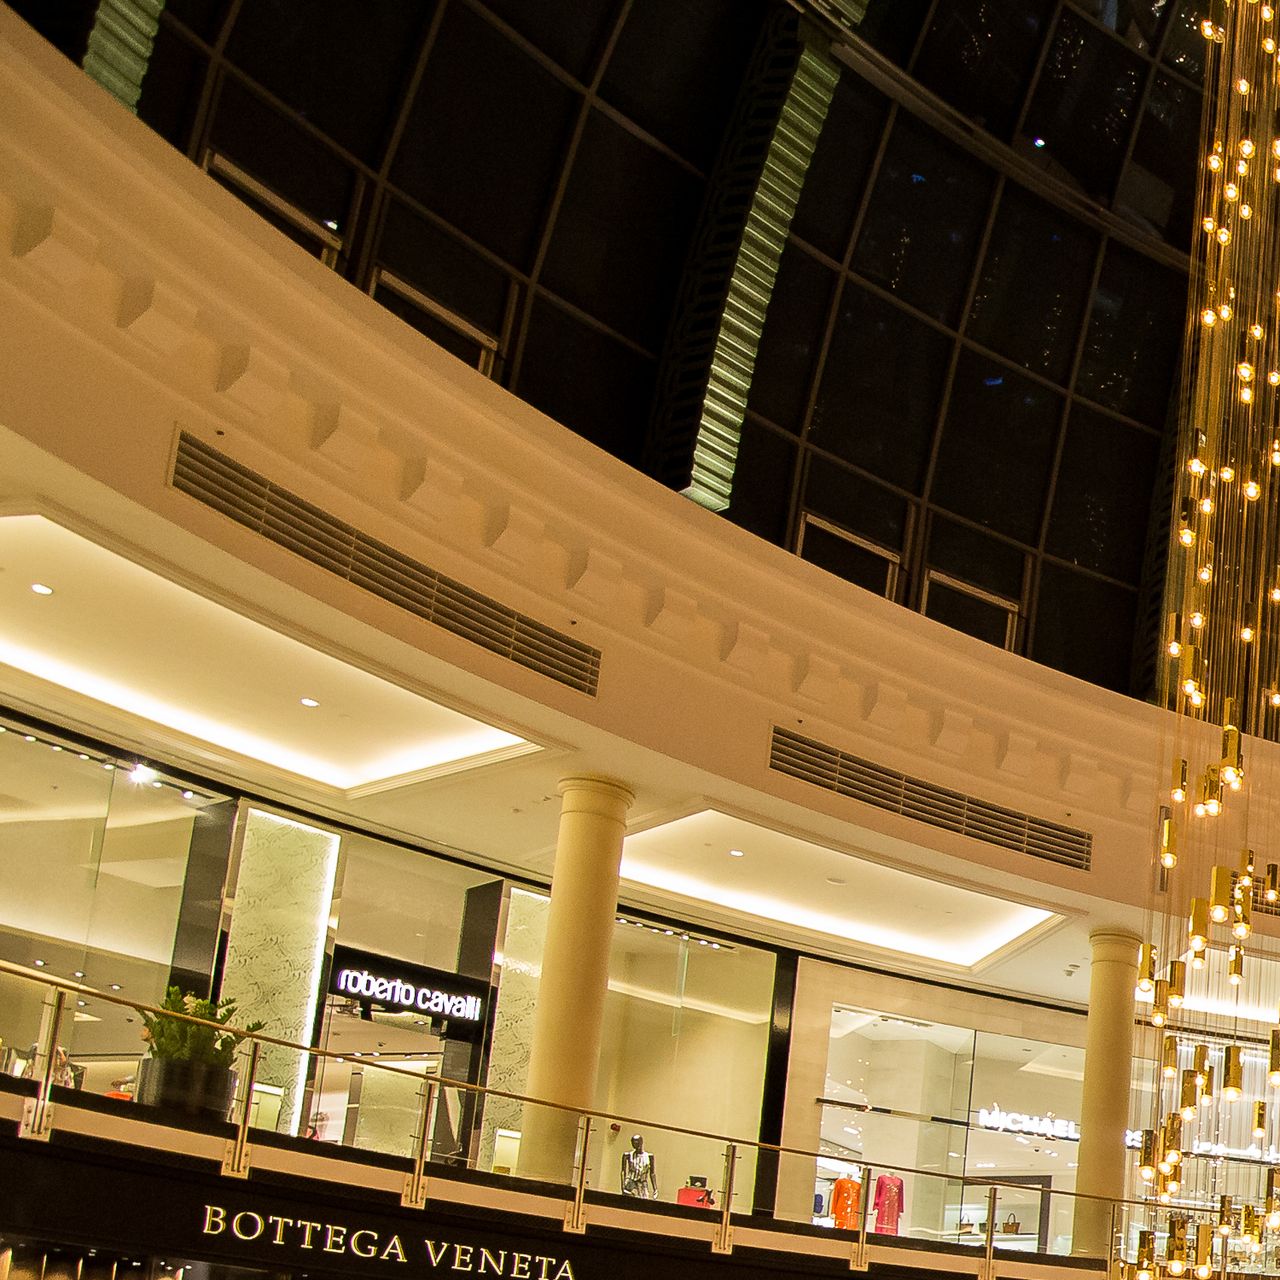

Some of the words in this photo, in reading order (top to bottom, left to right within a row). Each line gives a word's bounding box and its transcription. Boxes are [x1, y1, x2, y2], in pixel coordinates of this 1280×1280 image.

[338, 968, 415, 1006] roberto
[417, 986, 482, 1022] cavalli
[979, 1107, 1081, 1140] MICHAEL
[203, 1205, 407, 1263] BOTTEGA
